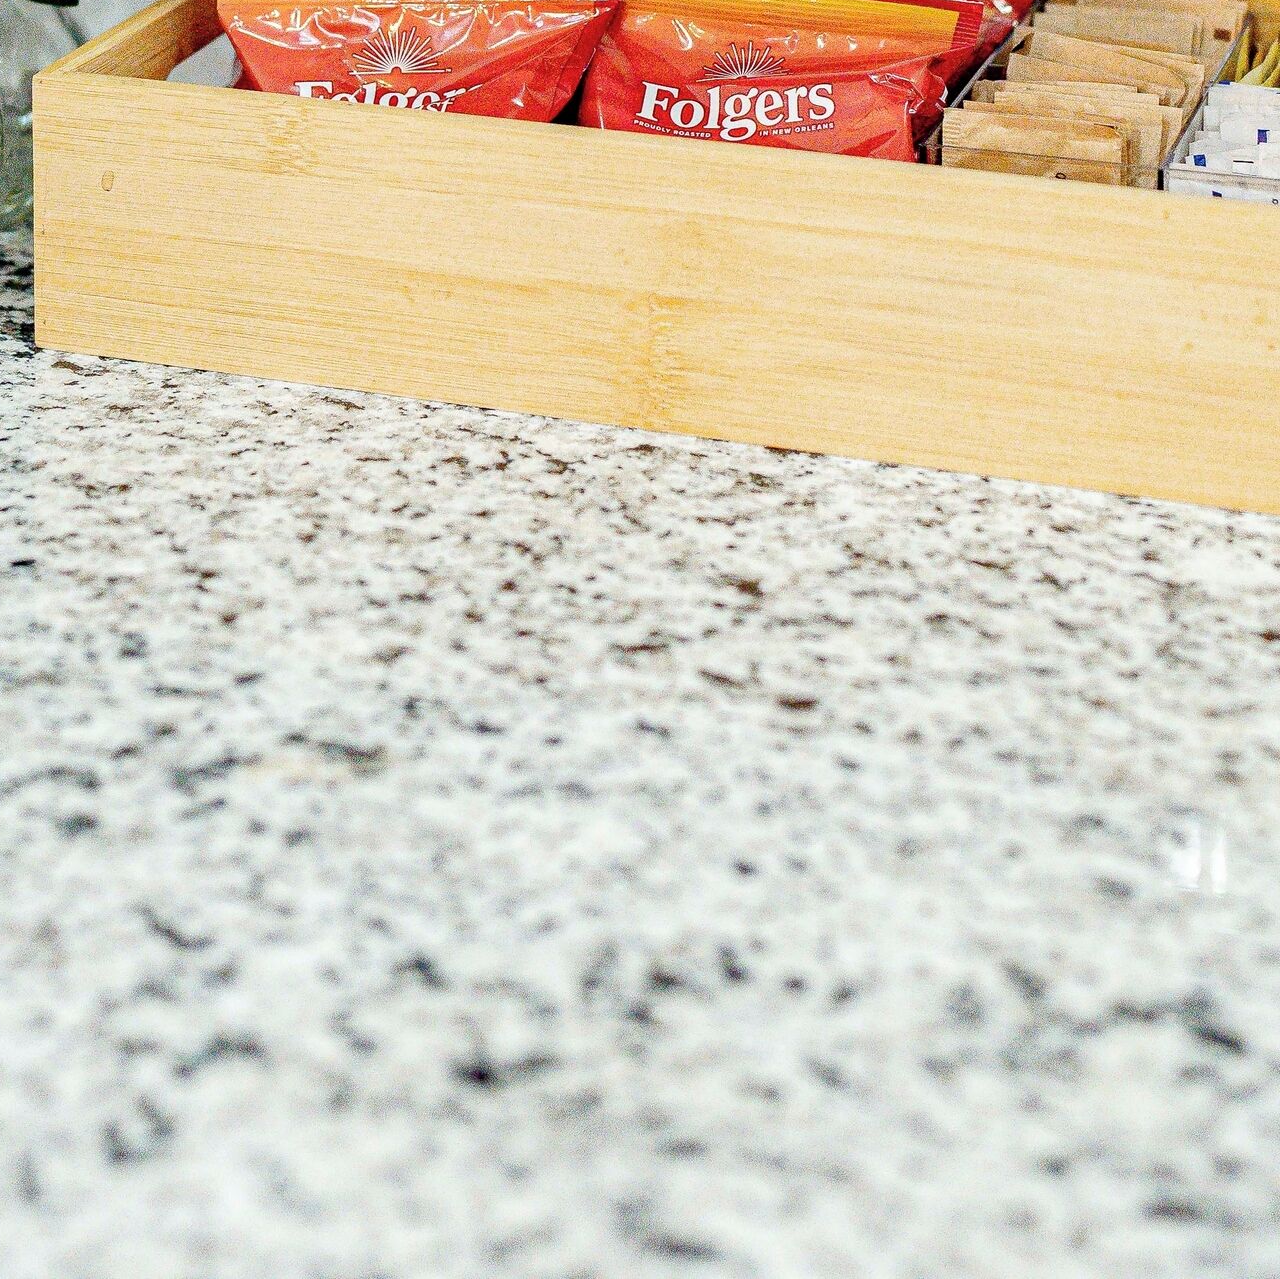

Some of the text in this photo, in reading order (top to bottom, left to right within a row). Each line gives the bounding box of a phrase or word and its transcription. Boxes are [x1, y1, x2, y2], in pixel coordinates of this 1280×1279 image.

[633, 120, 671, 134] PROUDLY
[673, 129, 711, 138] ROASTED
[772, 127, 791, 136] NEW
[794, 122, 835, 134] ORLEANS
[635, 81, 836, 142] Folgers
